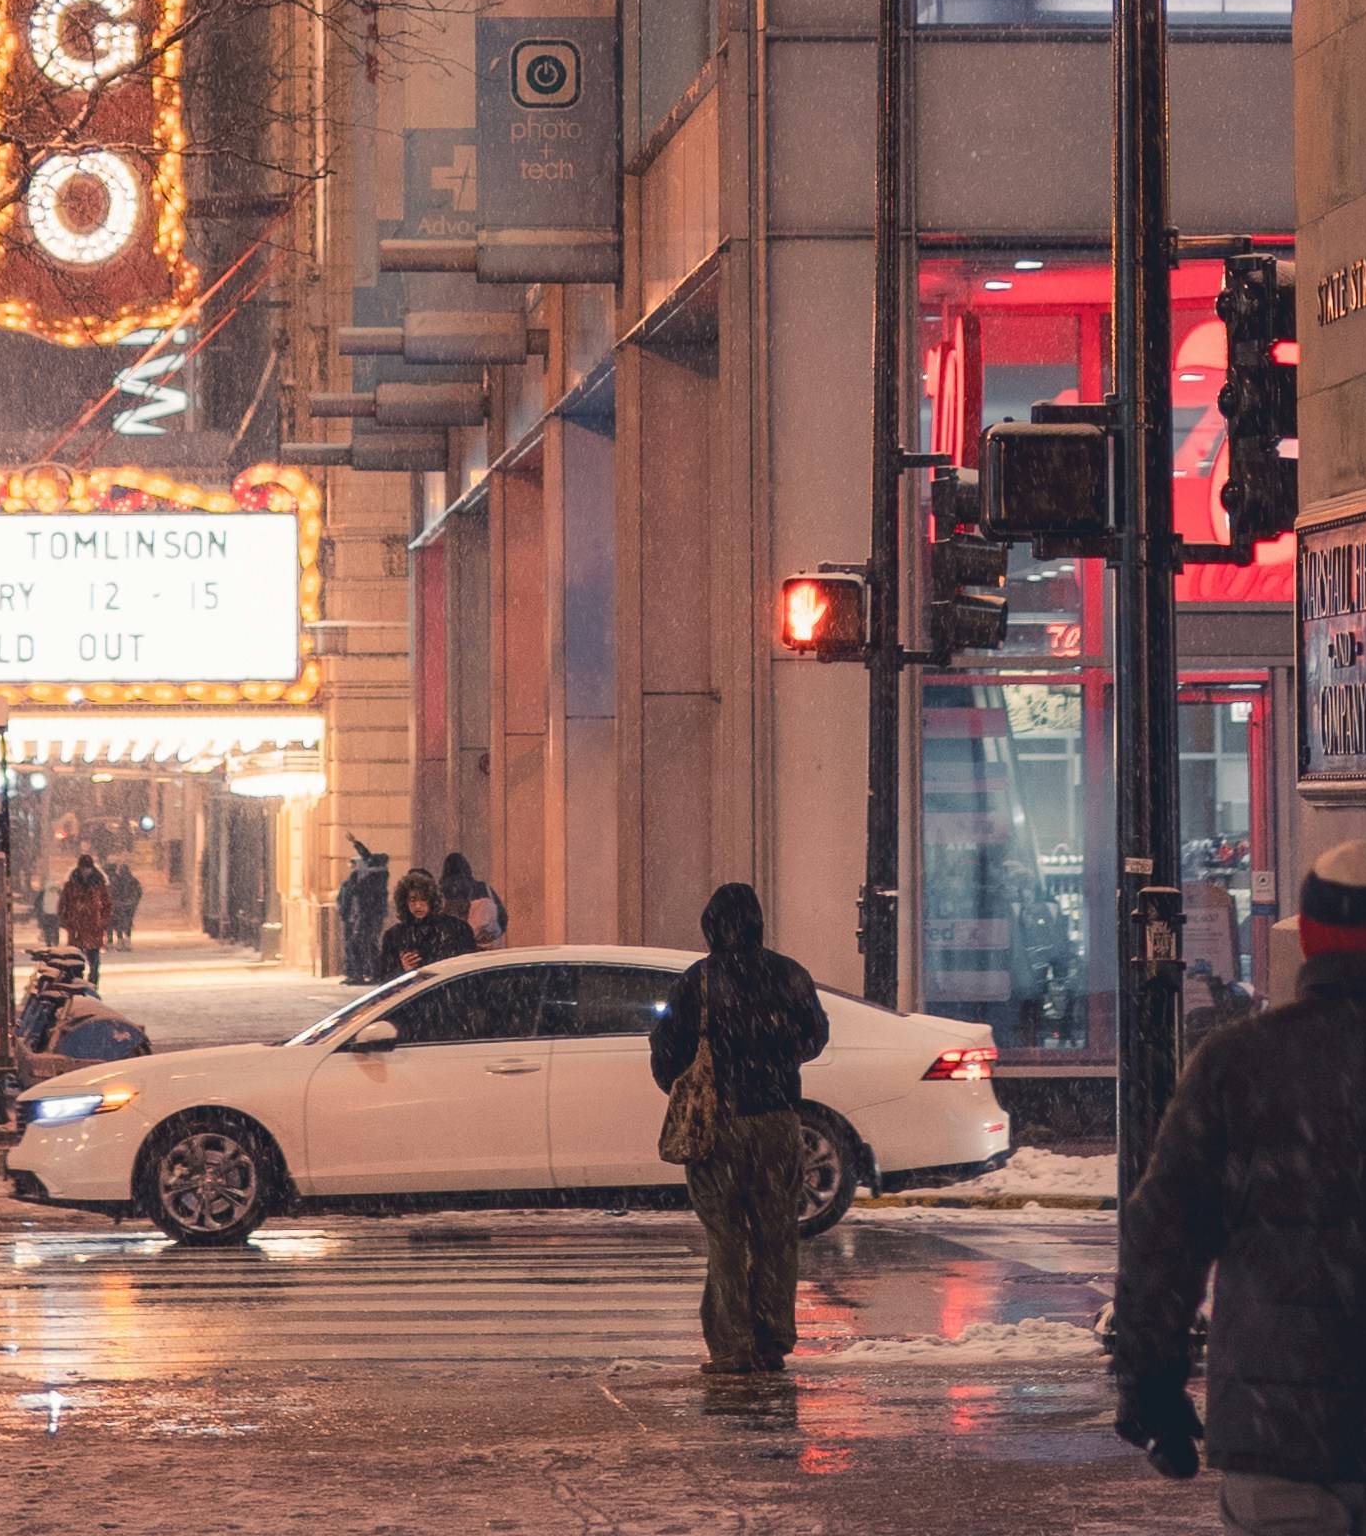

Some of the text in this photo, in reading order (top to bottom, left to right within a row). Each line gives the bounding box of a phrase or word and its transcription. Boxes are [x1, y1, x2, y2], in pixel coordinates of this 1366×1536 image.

[510, 116, 582, 143] photo
[521, 159, 575, 181] tech
[1317, 267, 1348, 327] STATE
[27, 529, 229, 561] TOMLINSON
[89, 581, 120, 611] 12
[190, 581, 219, 611] 15
[1299, 545, 1352, 622] MARSHALL
[79, 633, 146, 662] OUT
[1333, 631, 1355, 668] AND
